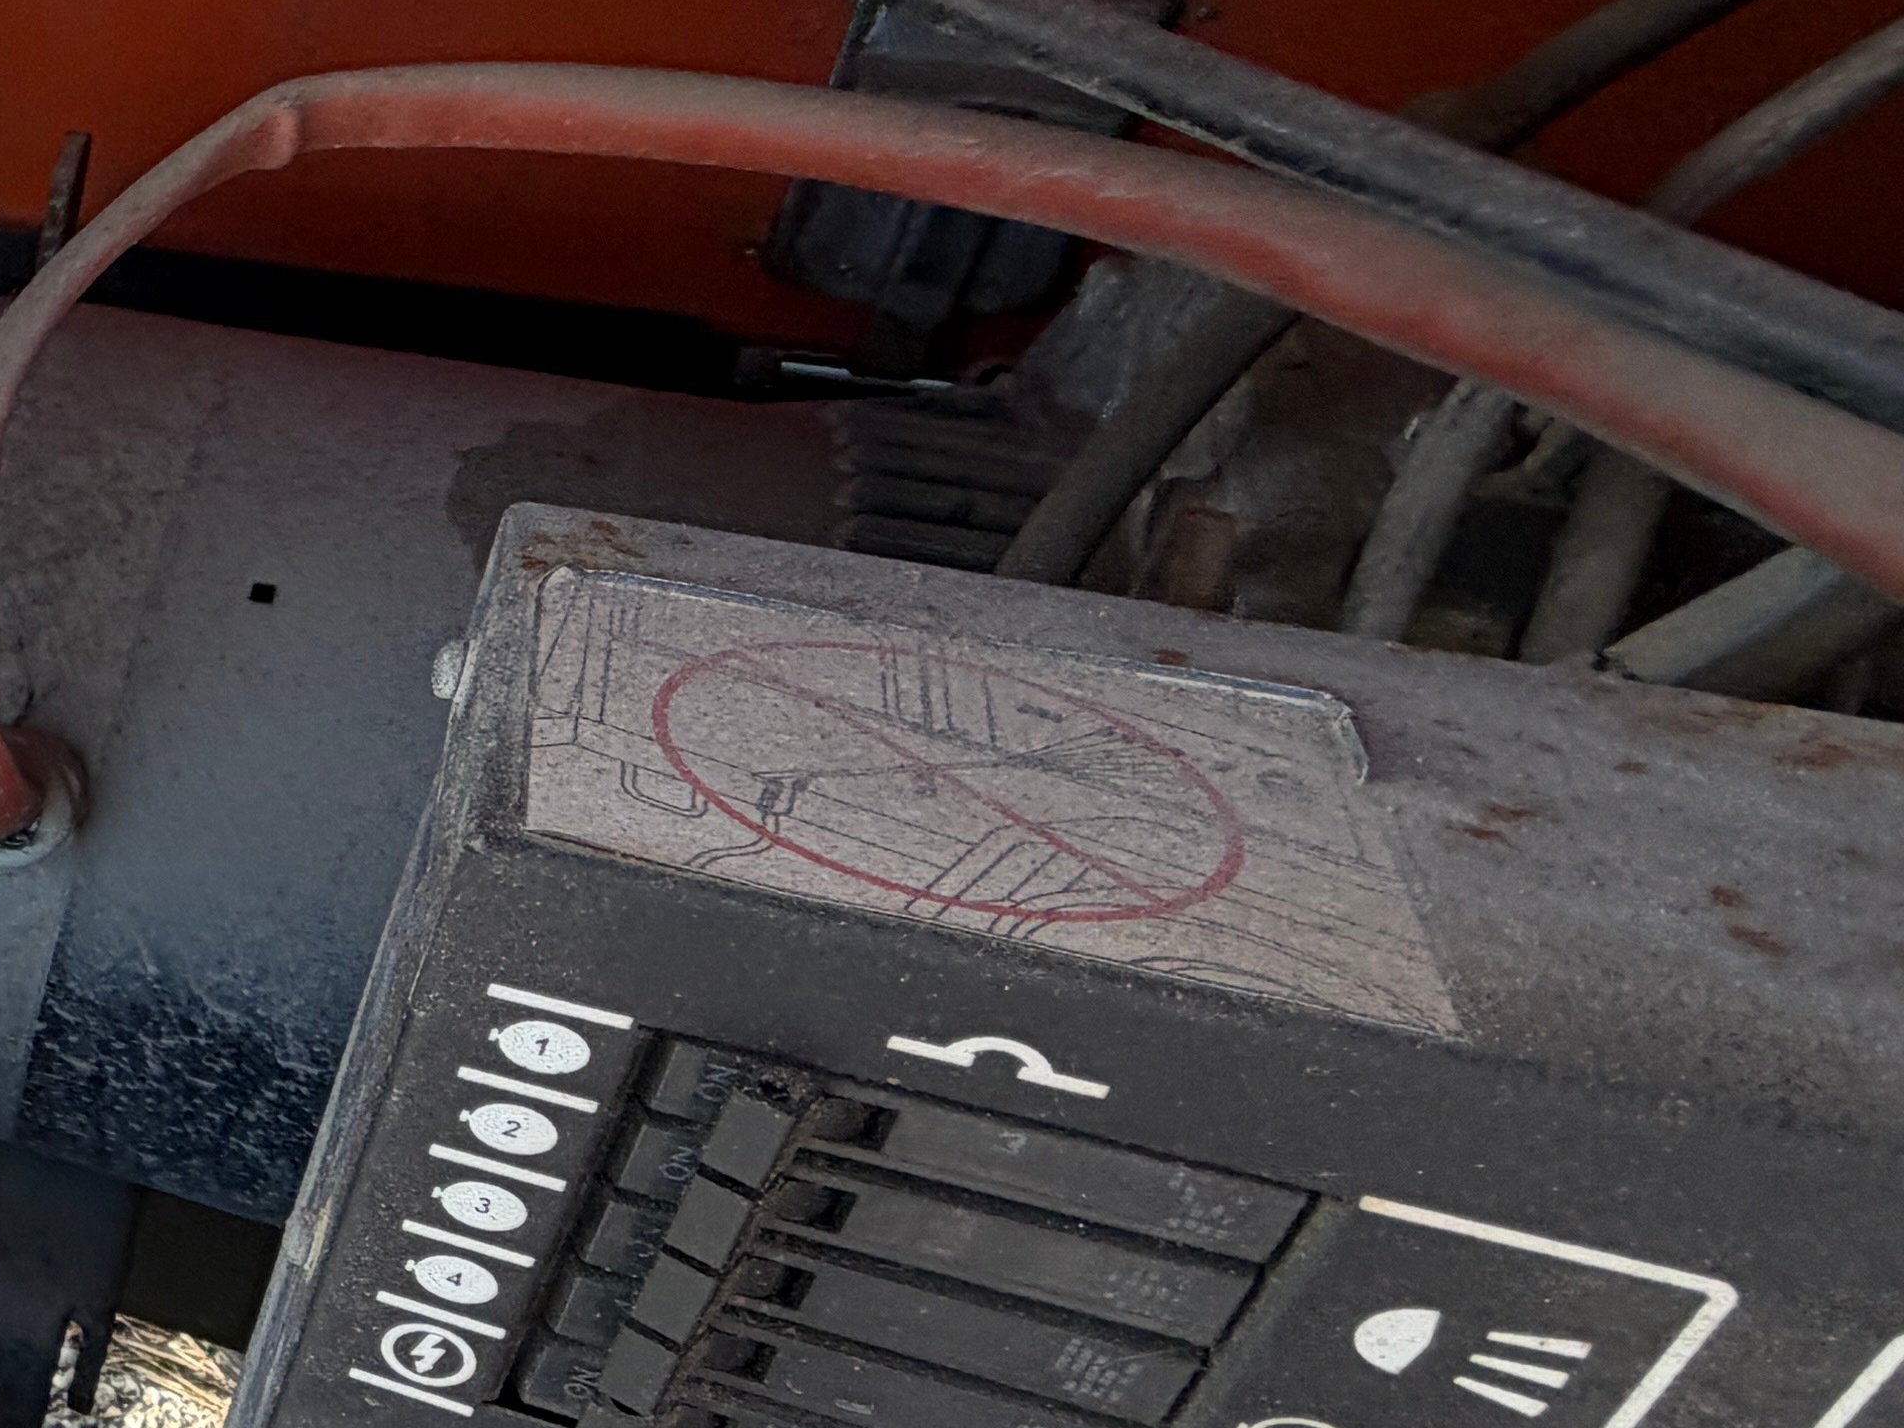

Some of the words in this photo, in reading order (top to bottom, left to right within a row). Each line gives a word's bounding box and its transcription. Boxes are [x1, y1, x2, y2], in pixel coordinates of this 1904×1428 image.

[535, 1037, 550, 1056] 1
[502, 1120, 522, 1138] 2
[659, 1145, 697, 1181] ON
[475, 1197, 491, 1214] 3
[446, 1272, 463, 1287] 4
